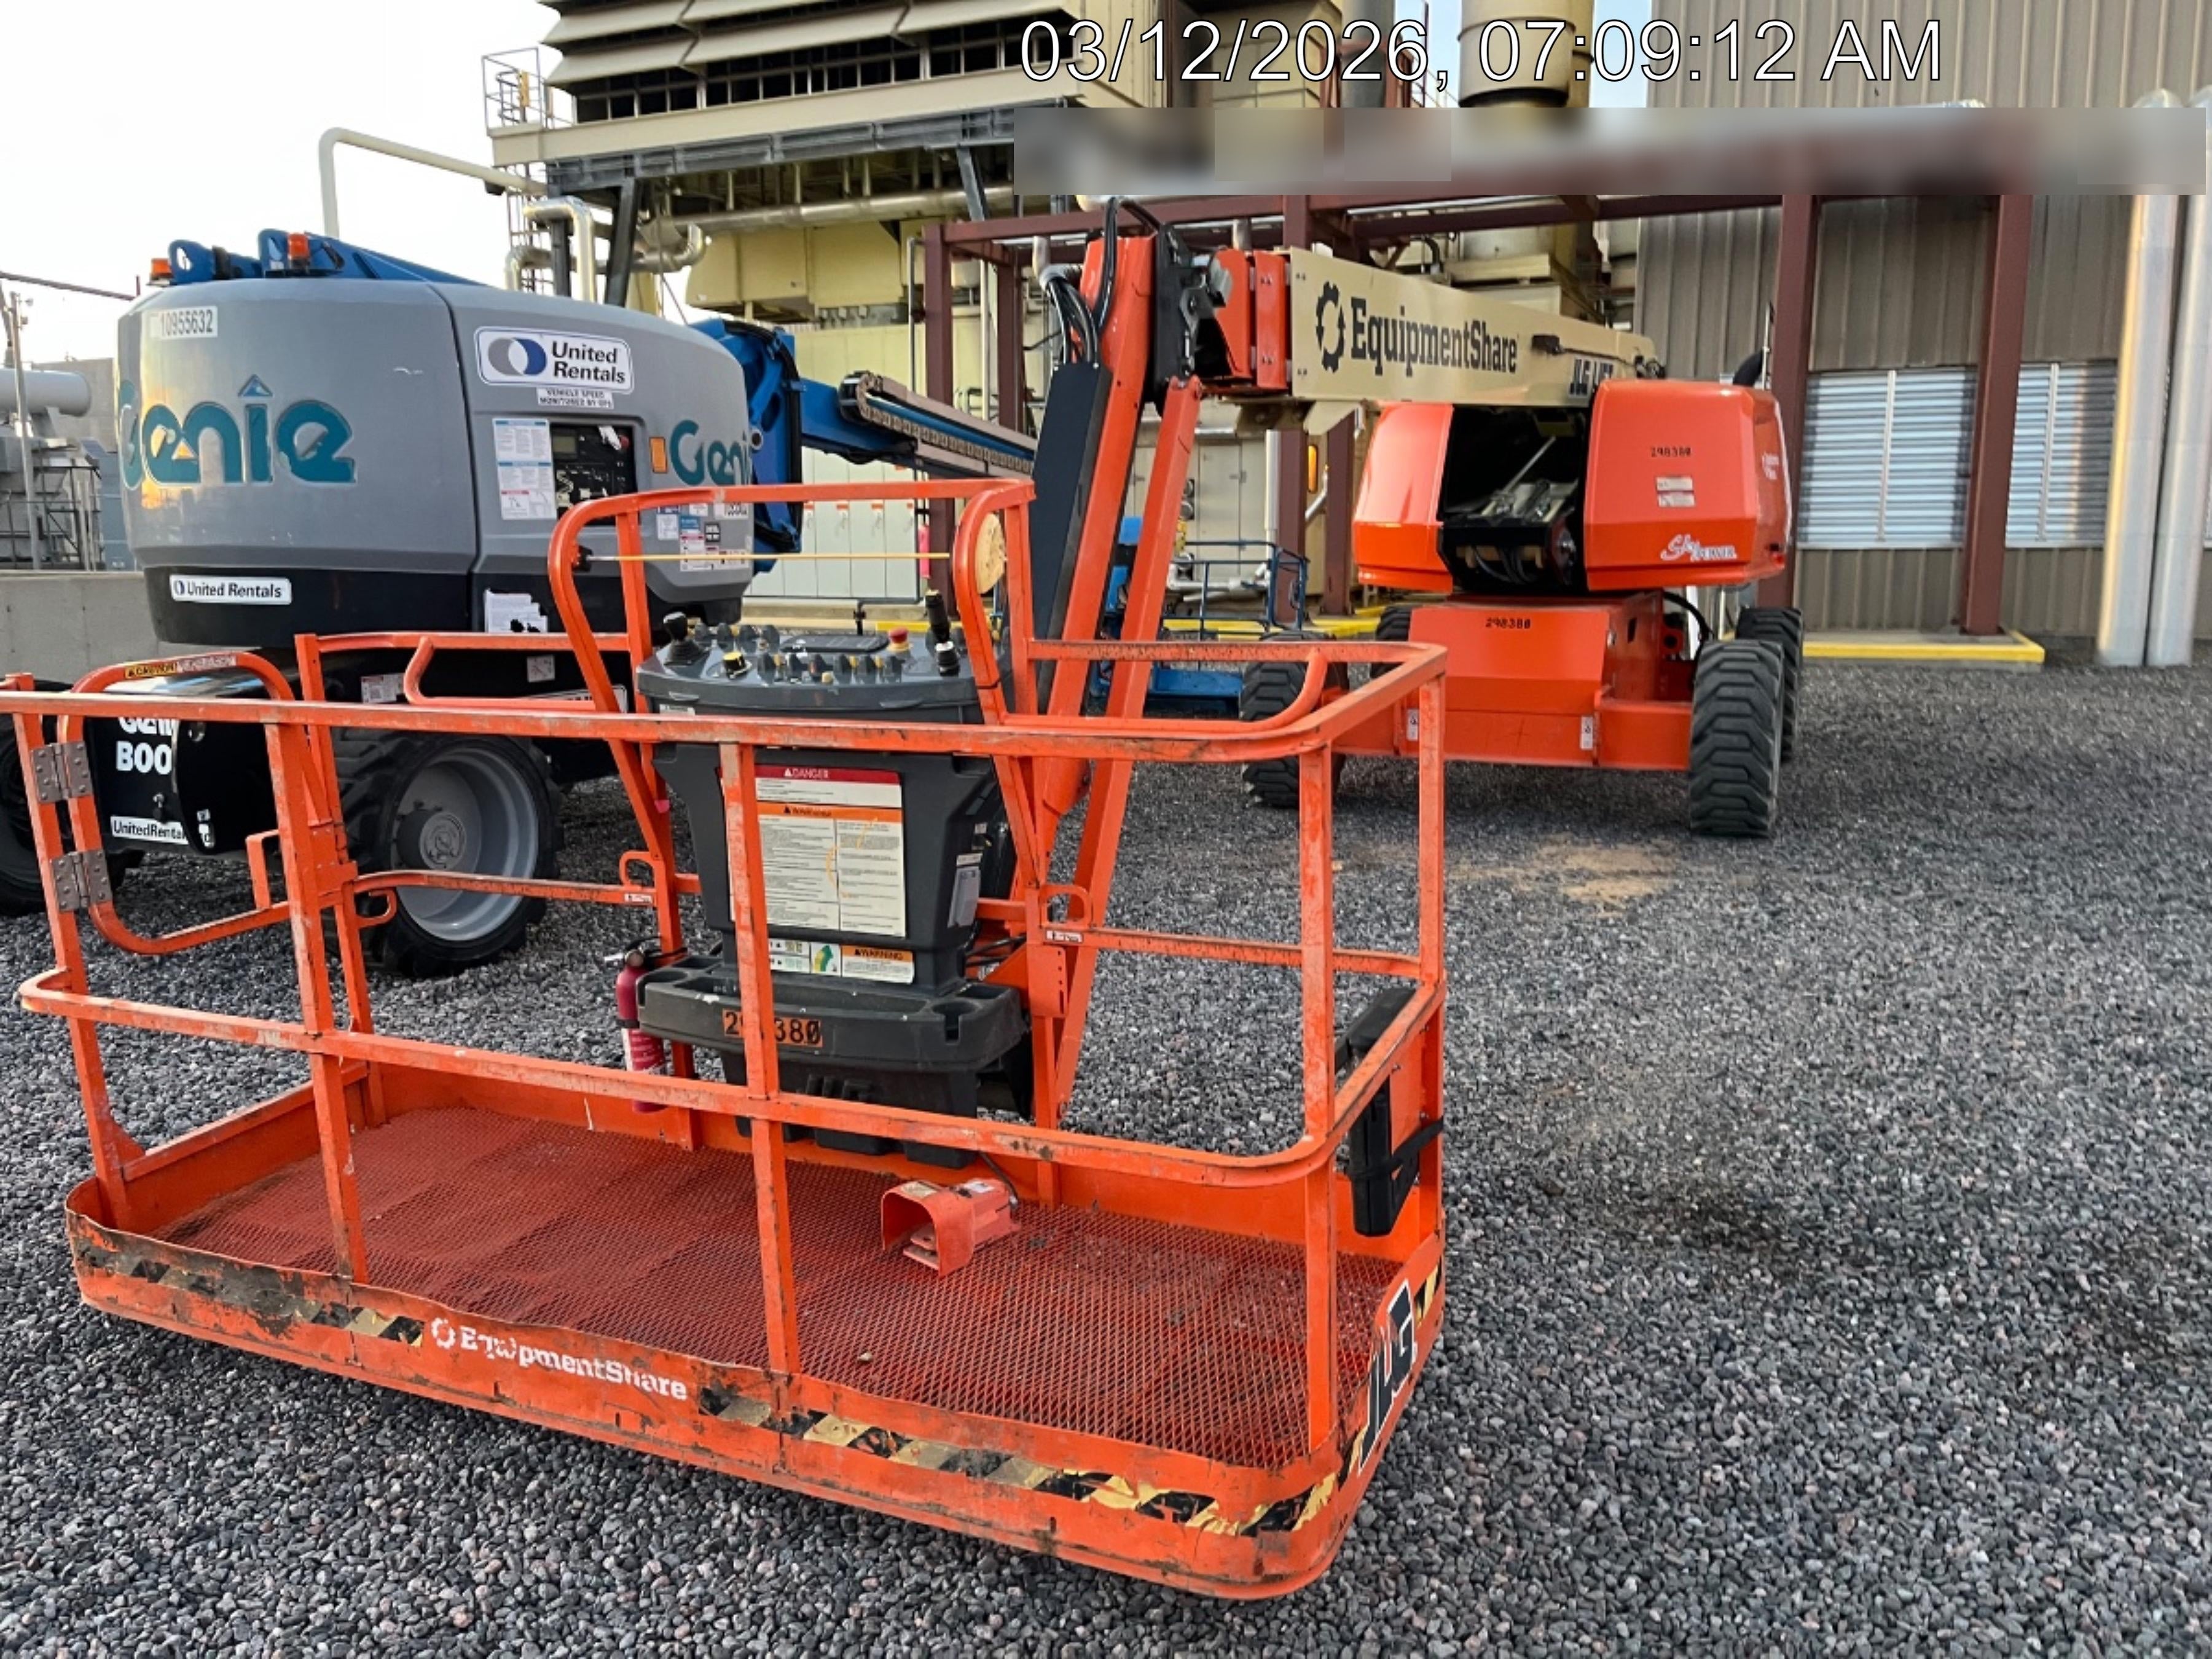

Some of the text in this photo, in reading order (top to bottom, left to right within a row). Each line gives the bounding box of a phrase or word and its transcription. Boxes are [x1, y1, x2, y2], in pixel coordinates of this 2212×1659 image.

[162, 309, 213, 335] 10955632
[1351, 296, 1516, 377] EquipmentShare
[552, 341, 617, 364] United
[554, 361, 626, 384] Rentals
[118, 374, 356, 490] Genie
[187, 581, 282, 598] United Rentals
[792, 769, 829, 779] DANGER
[860, 949, 904, 961] WARNING
[725, 1011, 820, 1045] 2380
